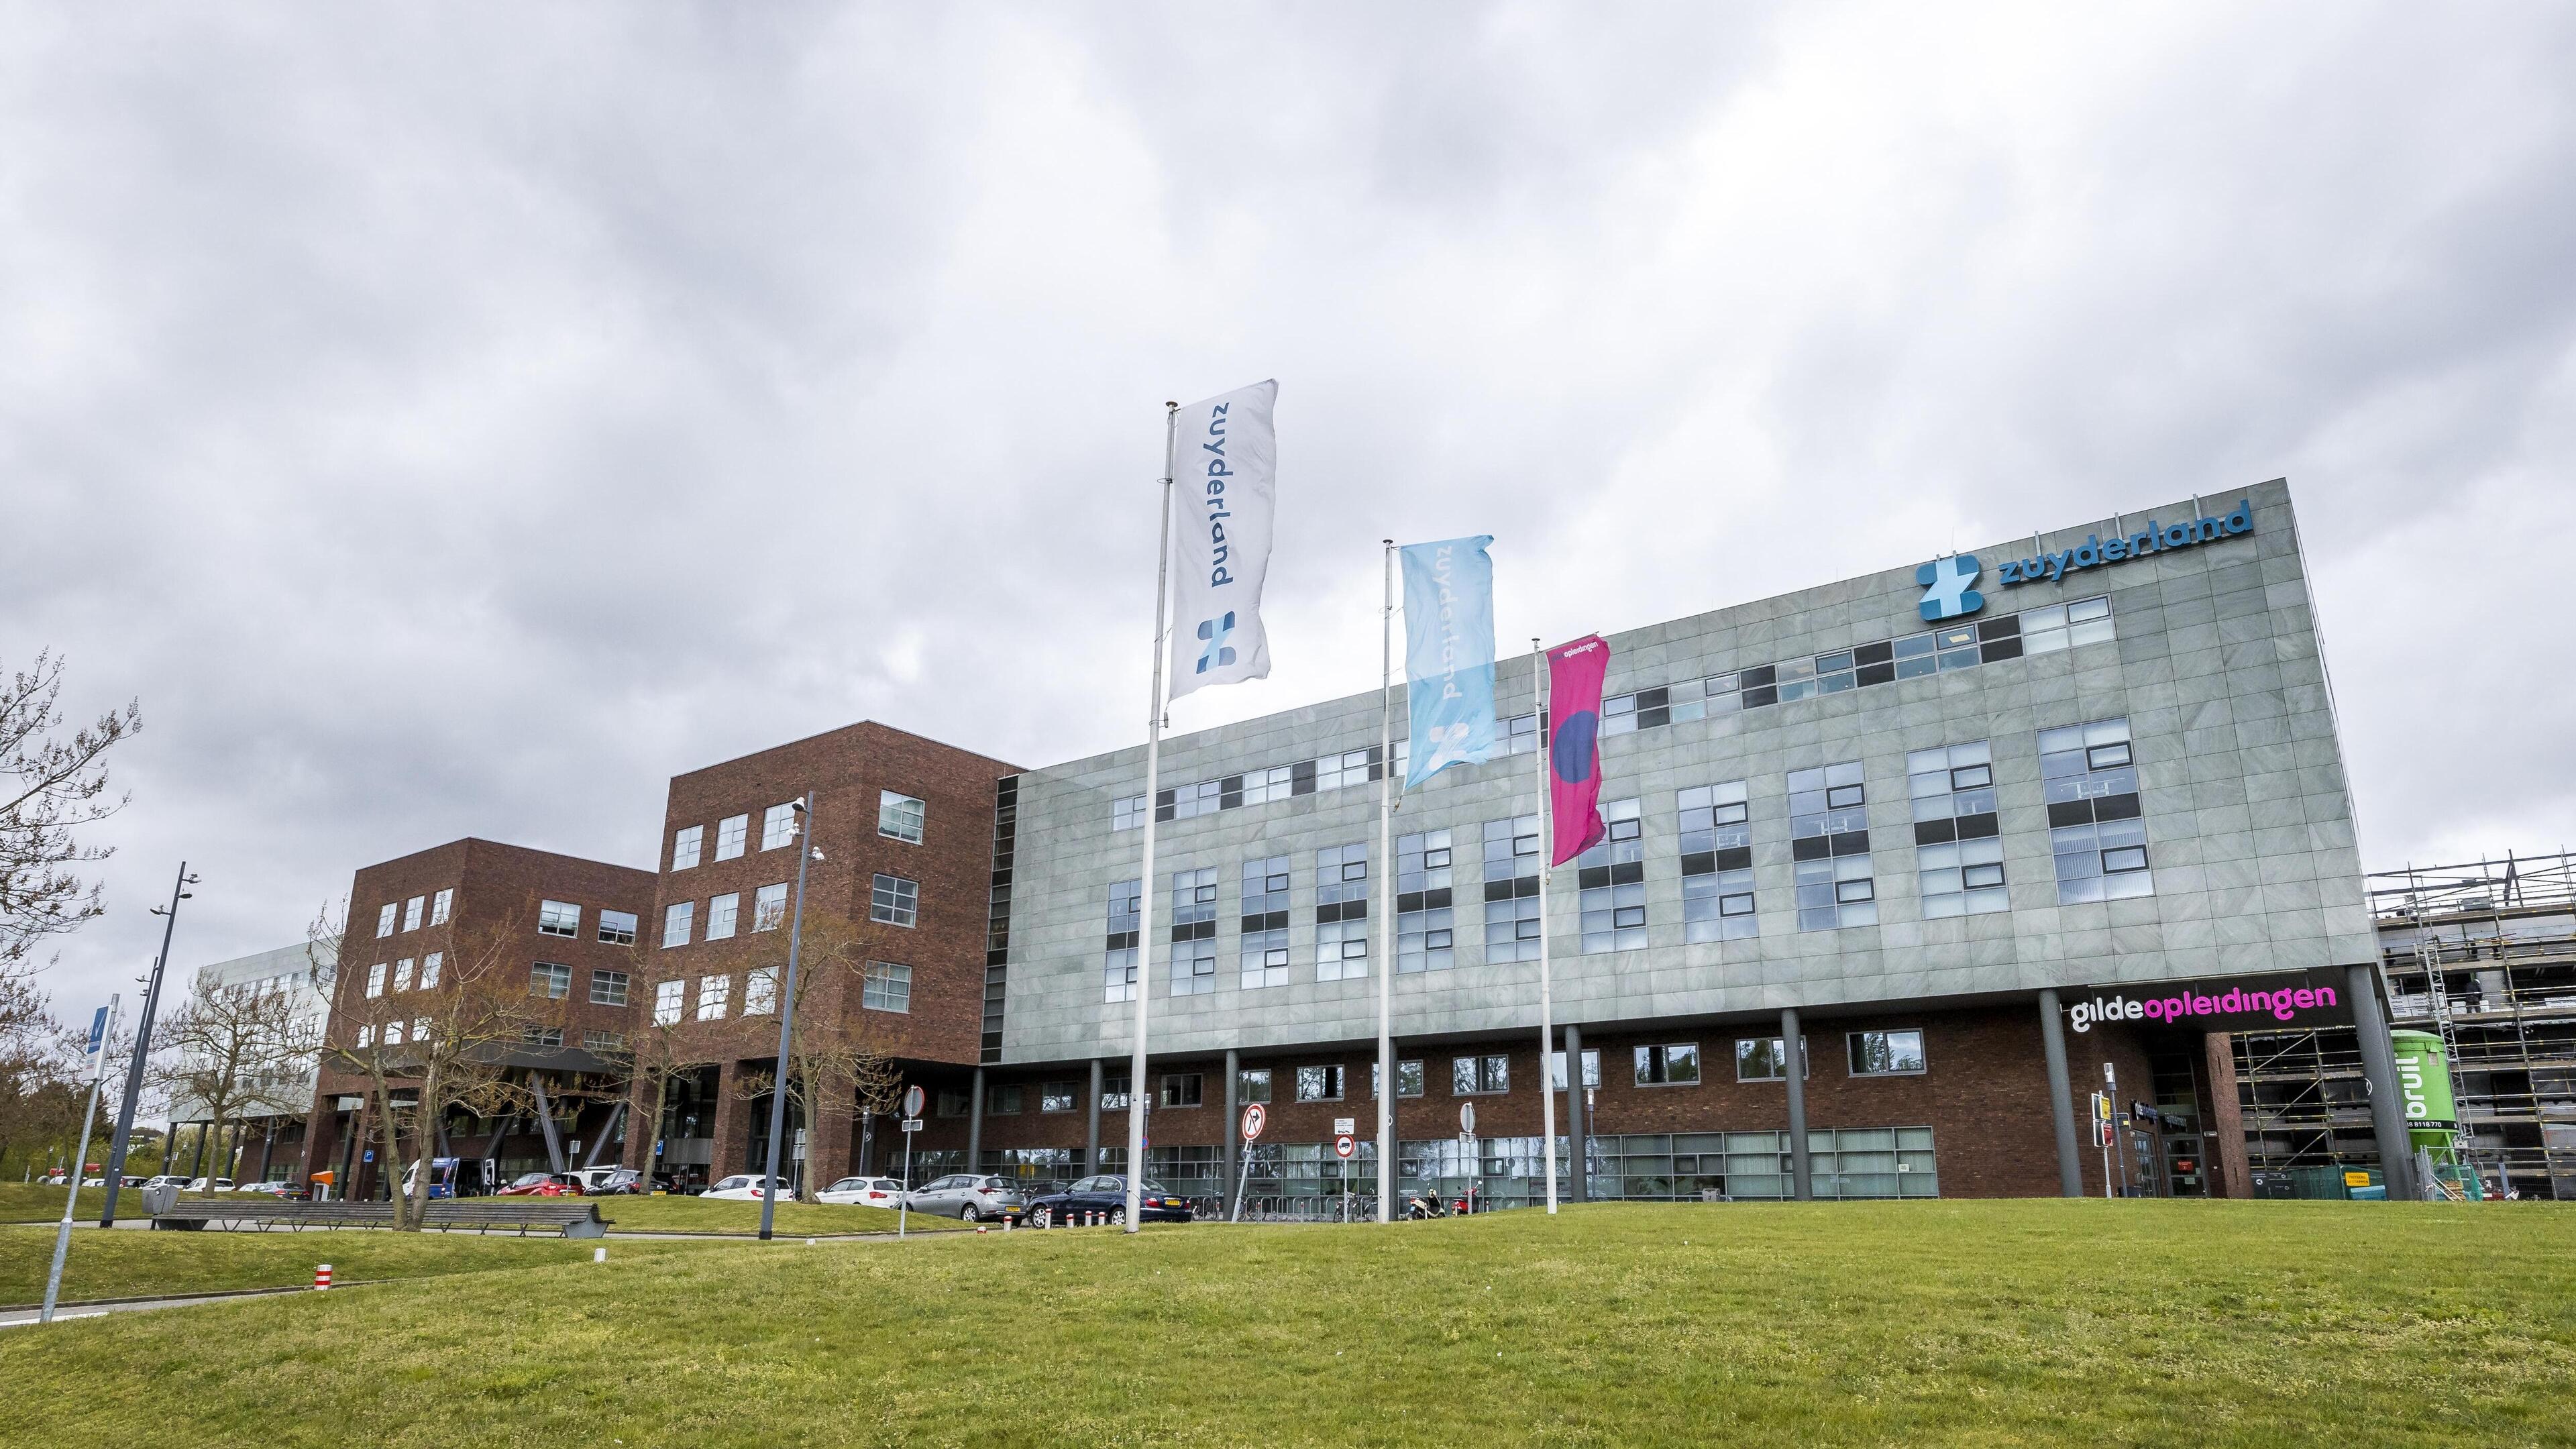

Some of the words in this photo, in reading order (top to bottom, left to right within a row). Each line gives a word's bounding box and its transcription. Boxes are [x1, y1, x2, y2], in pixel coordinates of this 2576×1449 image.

[1203, 402, 1234, 588] zuyderland
[1998, 499, 2253, 586] zuyderland
[1432, 545, 1463, 700] zuyderland
[2396, 1056, 2427, 1118] bruil
